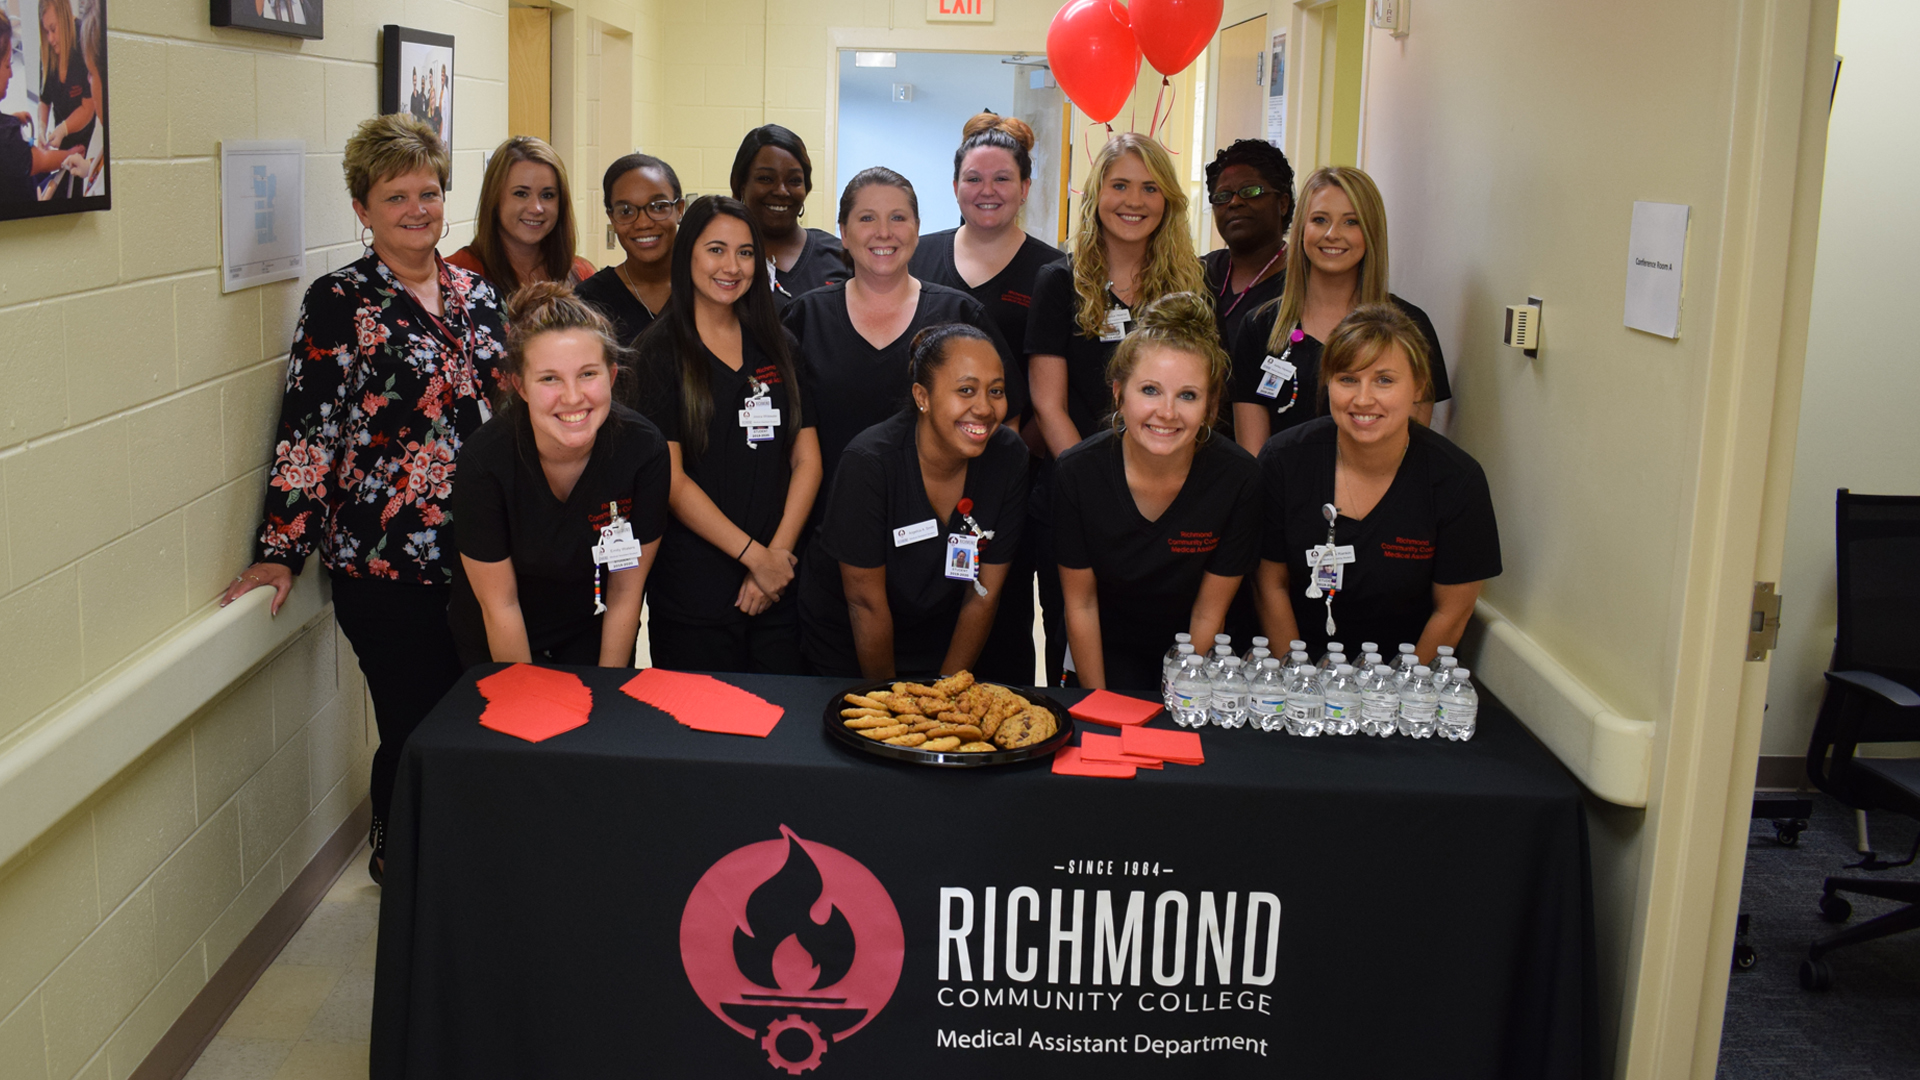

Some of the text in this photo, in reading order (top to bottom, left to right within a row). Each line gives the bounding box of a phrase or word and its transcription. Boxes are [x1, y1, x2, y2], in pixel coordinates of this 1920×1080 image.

[1636, 257, 1656, 268] Conference
[1657, 261, 1668, 269] Room
[1381, 542, 1418, 552] Community
[1396, 537, 1429, 546] Richmond
[1068, 859, 1113, 876] SINCE
[938, 886, 1282, 987] RICHMOND
[937, 987, 1272, 1015] COMMUNITY COLLEGE
[937, 1028, 1268, 1059] Medical Assistant Department
